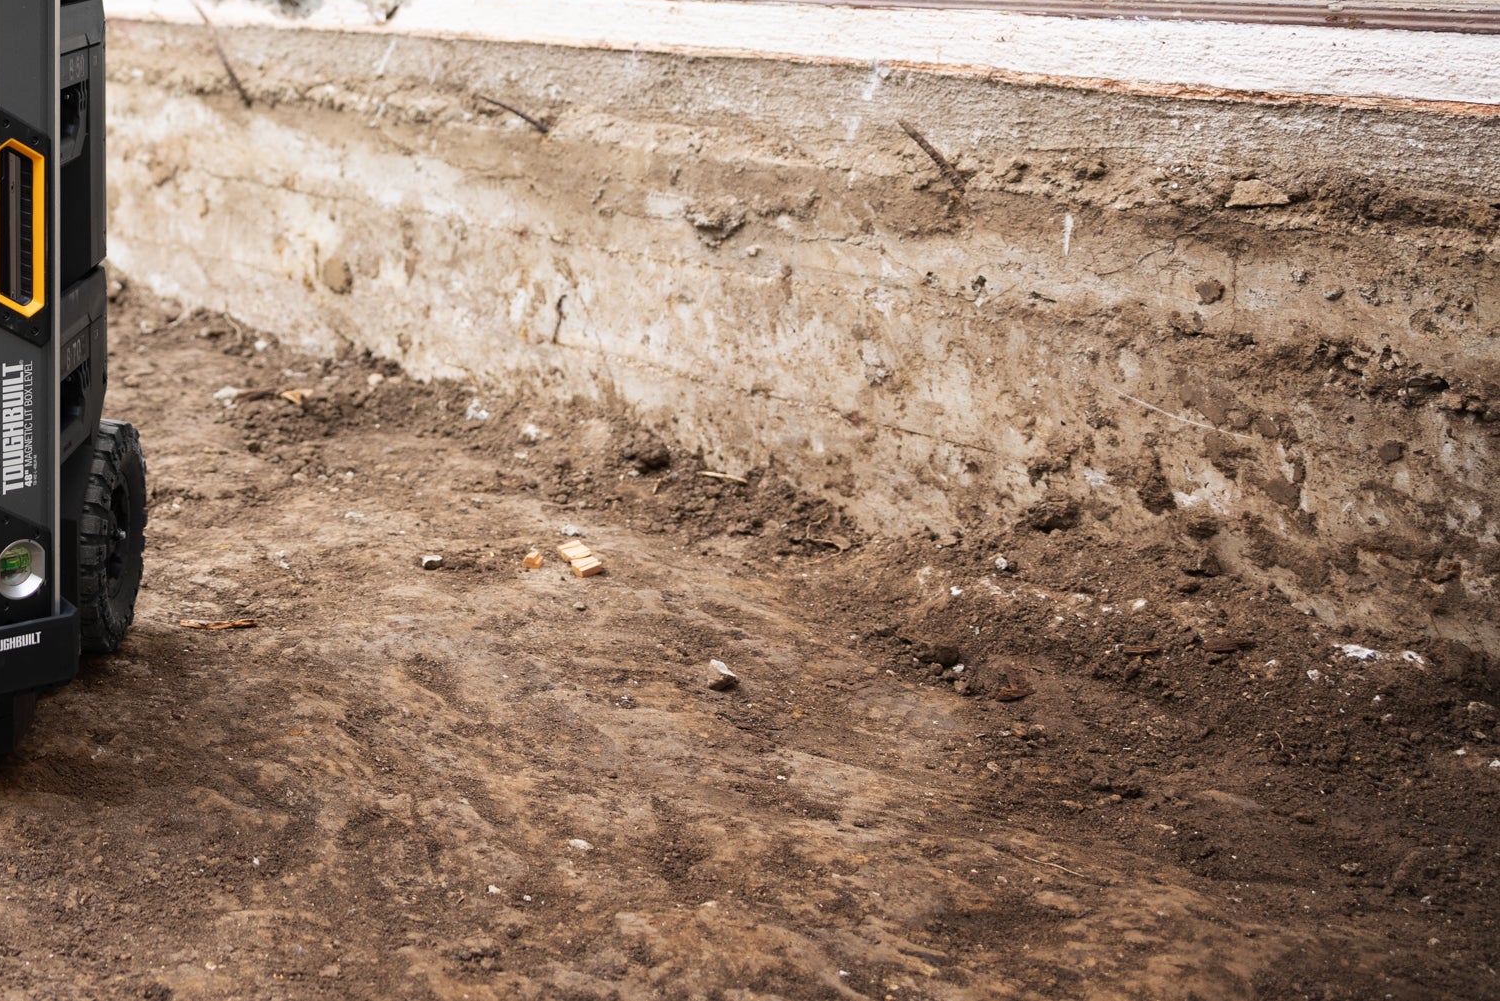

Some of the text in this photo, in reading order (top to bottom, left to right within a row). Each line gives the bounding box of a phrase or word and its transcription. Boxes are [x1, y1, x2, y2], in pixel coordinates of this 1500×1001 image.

[24, 360, 33, 387] LEVEL
[24, 388, 33, 407] BOX
[2, 361, 24, 495] TOUGHBUILT
[24, 408, 33, 421] LIT
[24, 422, 33, 467] MAGNETIC
